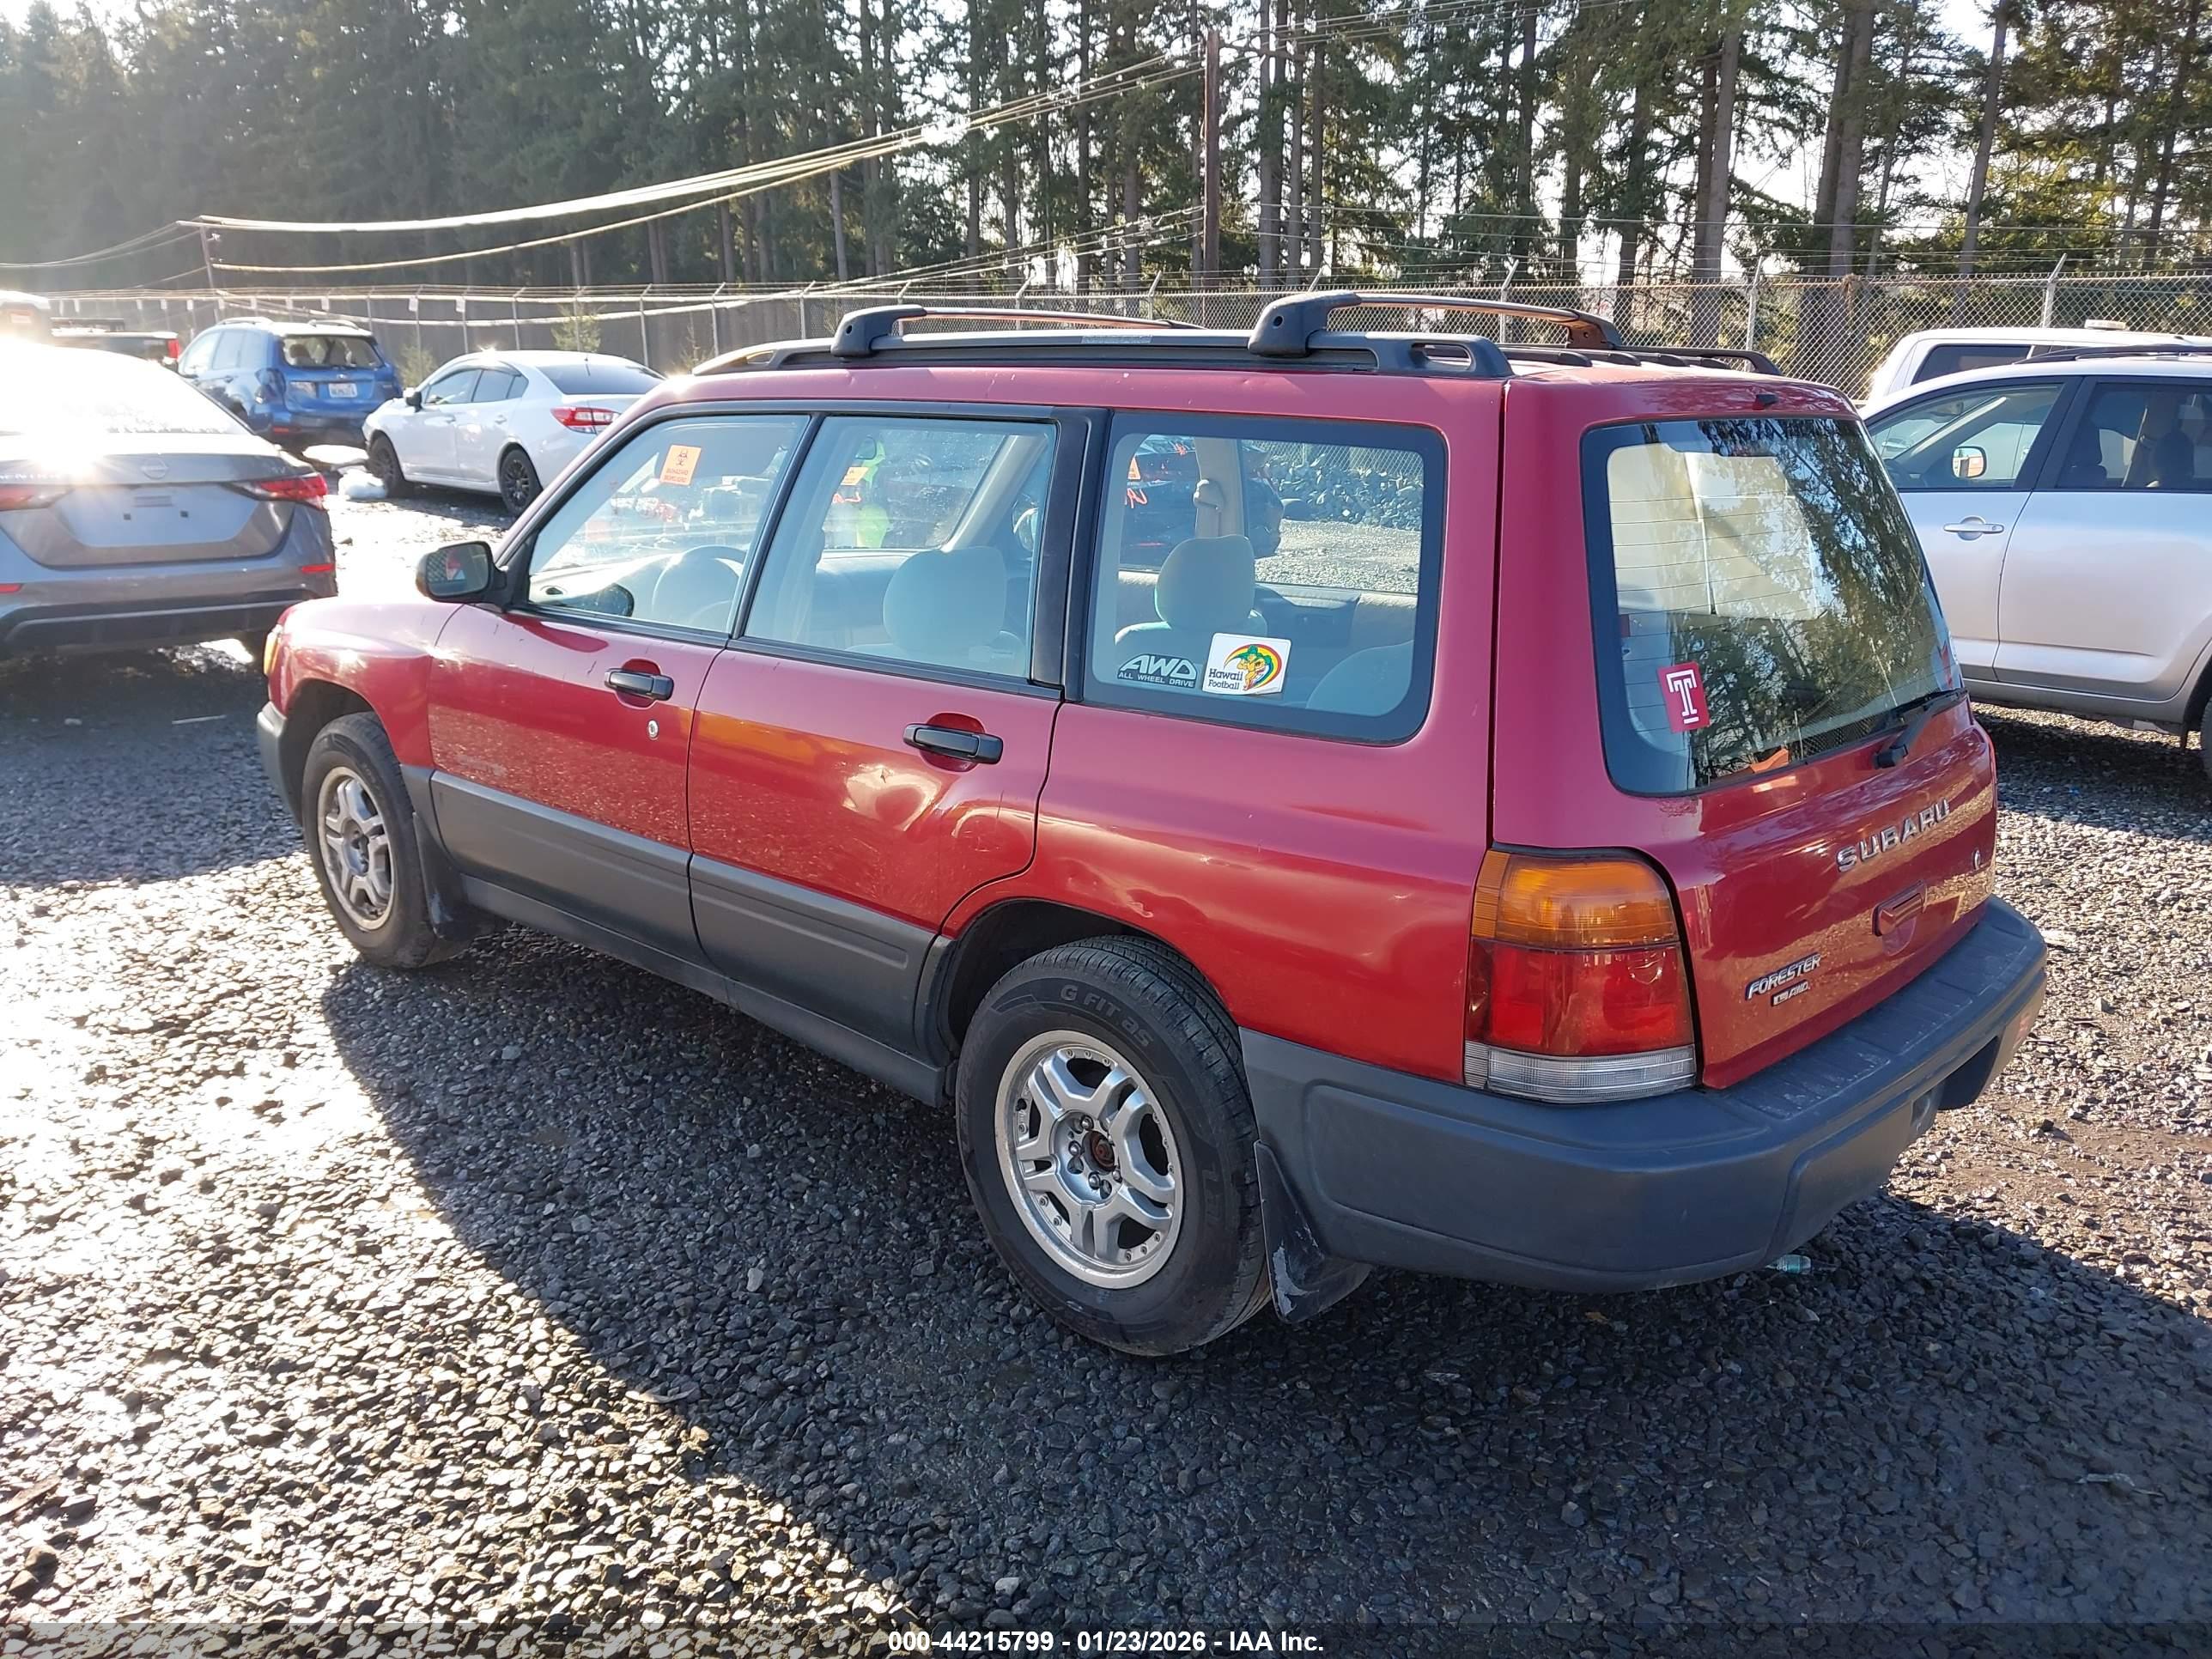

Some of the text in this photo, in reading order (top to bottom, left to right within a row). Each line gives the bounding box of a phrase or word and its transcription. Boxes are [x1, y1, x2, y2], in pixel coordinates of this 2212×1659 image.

[1119, 654, 1196, 679] AWD
[1208, 668, 1243, 681] Hawaii
[1137, 675, 1165, 684] WHEEL
[1169, 678, 1194, 688] DRIVE
[1208, 679, 1240, 690] Football
[1837, 798, 1949, 872] SUBARU
[1747, 953, 1821, 999] FORESTER
[1060, 986, 1078, 1001] G
[1085, 994, 1119, 1016] FIT
